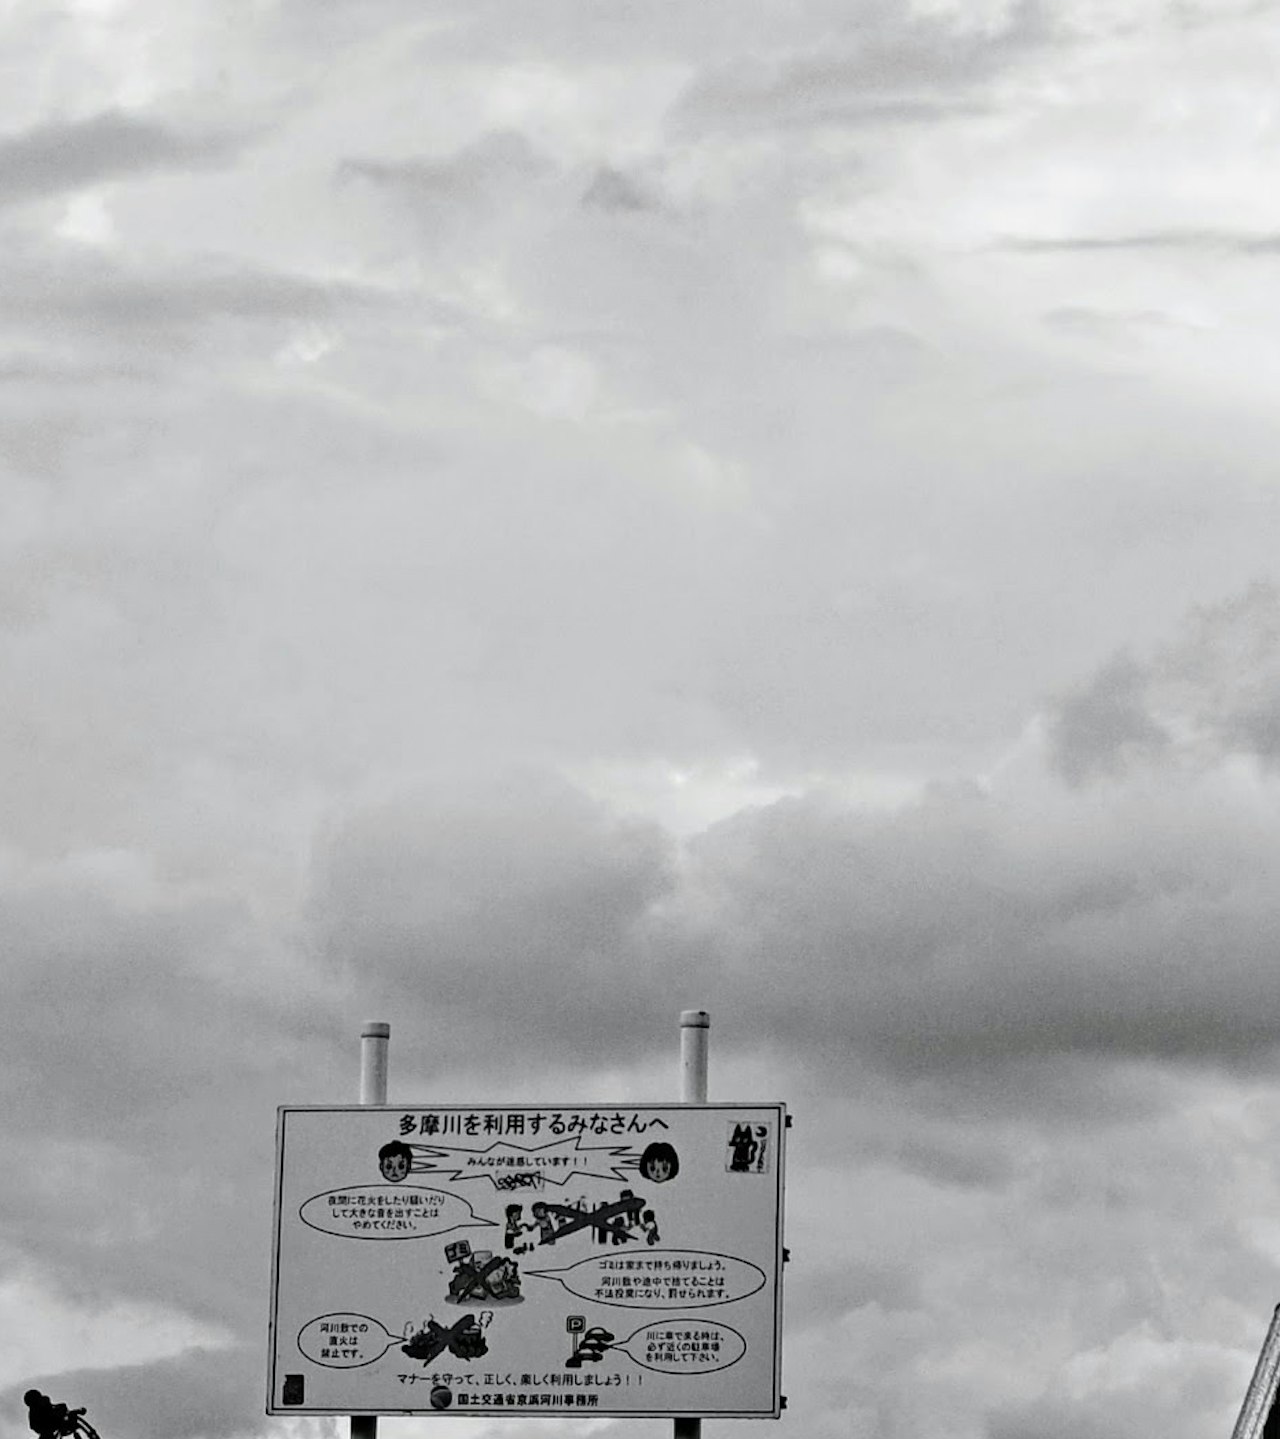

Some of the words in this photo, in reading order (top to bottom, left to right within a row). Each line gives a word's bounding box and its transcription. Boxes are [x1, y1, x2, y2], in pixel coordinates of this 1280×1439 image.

[399, 1114, 669, 1136] 多摩川を利用するみなさんへ
